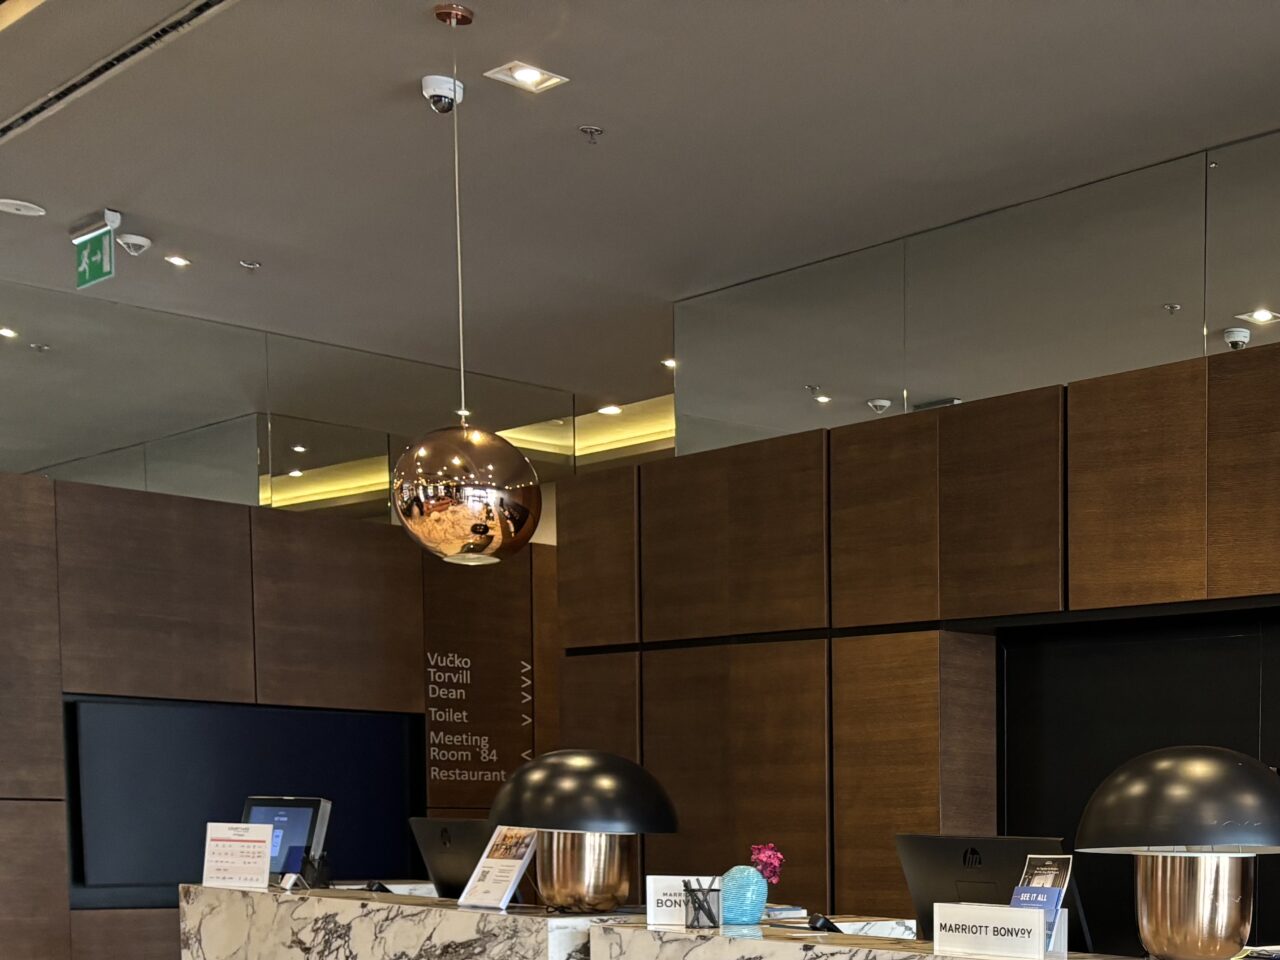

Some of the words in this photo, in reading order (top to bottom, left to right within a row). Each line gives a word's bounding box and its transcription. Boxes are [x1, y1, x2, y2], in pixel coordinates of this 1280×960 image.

[427, 652, 471, 668] Vučko
[427, 668, 471, 684] Torvill
[428, 685, 466, 699] Dean
[428, 707, 469, 723] Toilet
[429, 731, 489, 749] Meeting
[430, 747, 472, 761] Room
[430, 767, 507, 782] Restaurant
[656, 898, 691, 908] BONV
[1020, 893, 1031, 901] SEE
[1037, 894, 1047, 902] ALL
[939, 922, 990, 936] MARRIOTT
